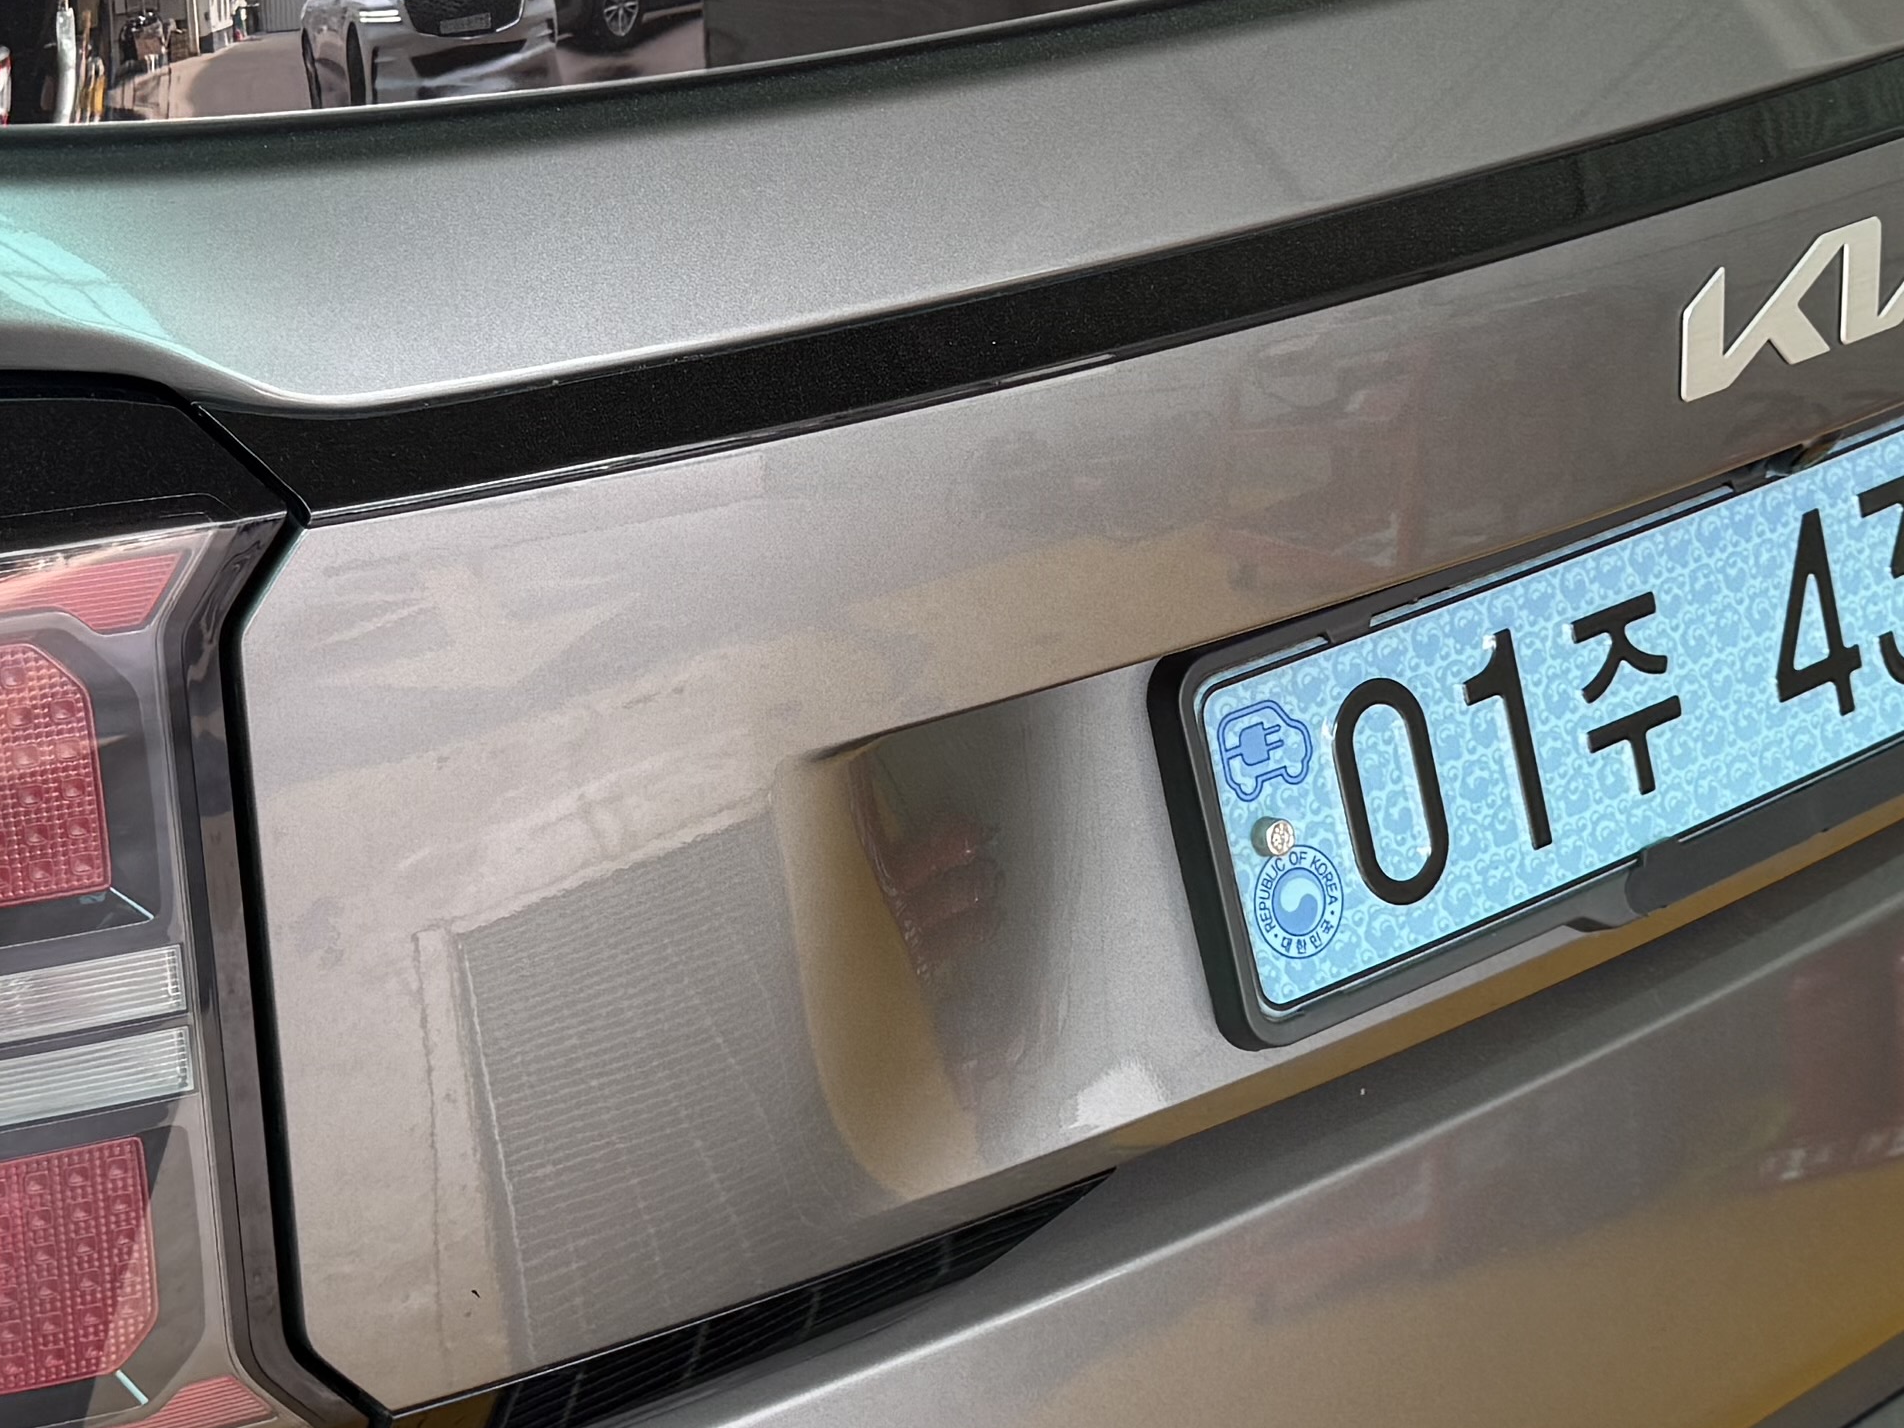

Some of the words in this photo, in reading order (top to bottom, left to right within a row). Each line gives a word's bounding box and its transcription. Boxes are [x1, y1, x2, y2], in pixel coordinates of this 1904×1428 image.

[1331, 590, 1683, 906] 01주
[1258, 857, 1286, 933] REPUBLIC
[1288, 850, 1308, 866] OF
[1309, 855, 1338, 905] KOREA
